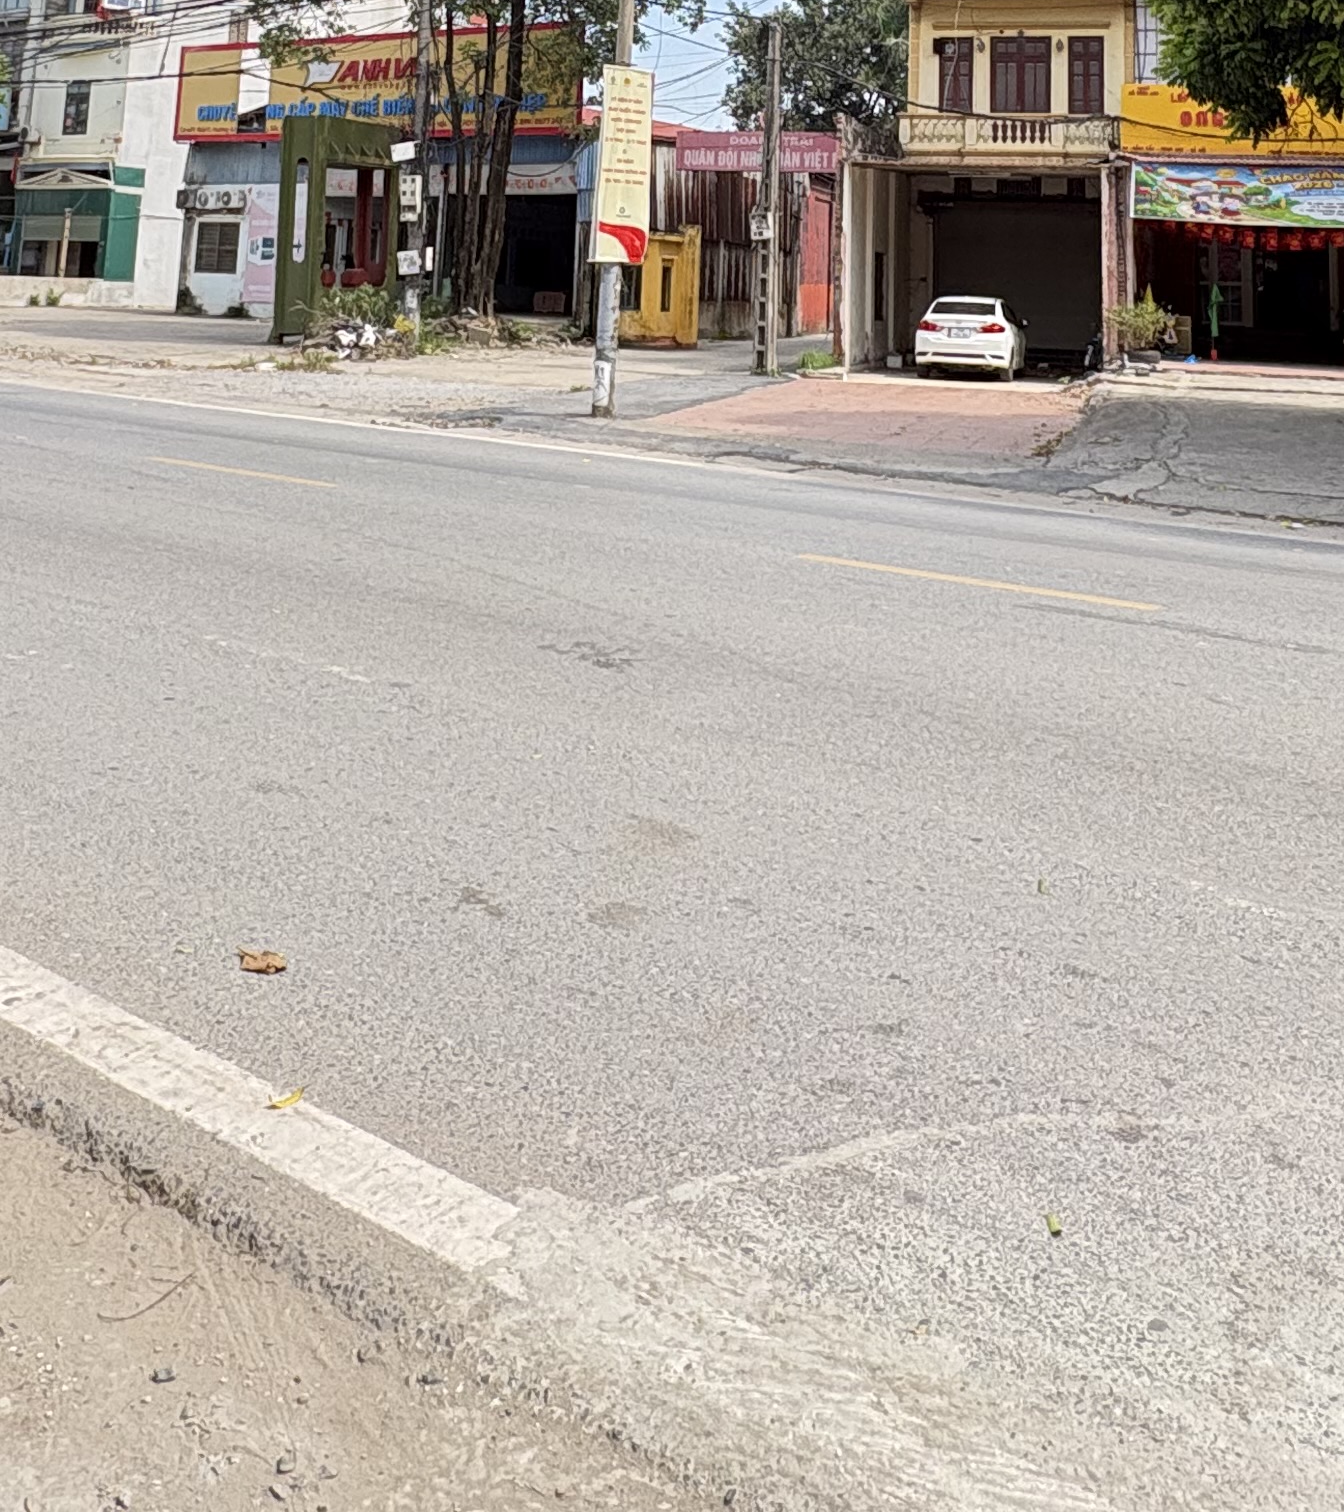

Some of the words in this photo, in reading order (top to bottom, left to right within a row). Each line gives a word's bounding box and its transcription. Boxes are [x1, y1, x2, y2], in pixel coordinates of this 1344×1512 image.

[337, 57, 392, 82] ANH
[197, 102, 238, 122] CHUYÊ
[683, 148, 715, 167] QUÂN
[717, 146, 738, 169] ĐỘI
[780, 148, 801, 168] ÂN
[803, 148, 829, 170] VIỆT
